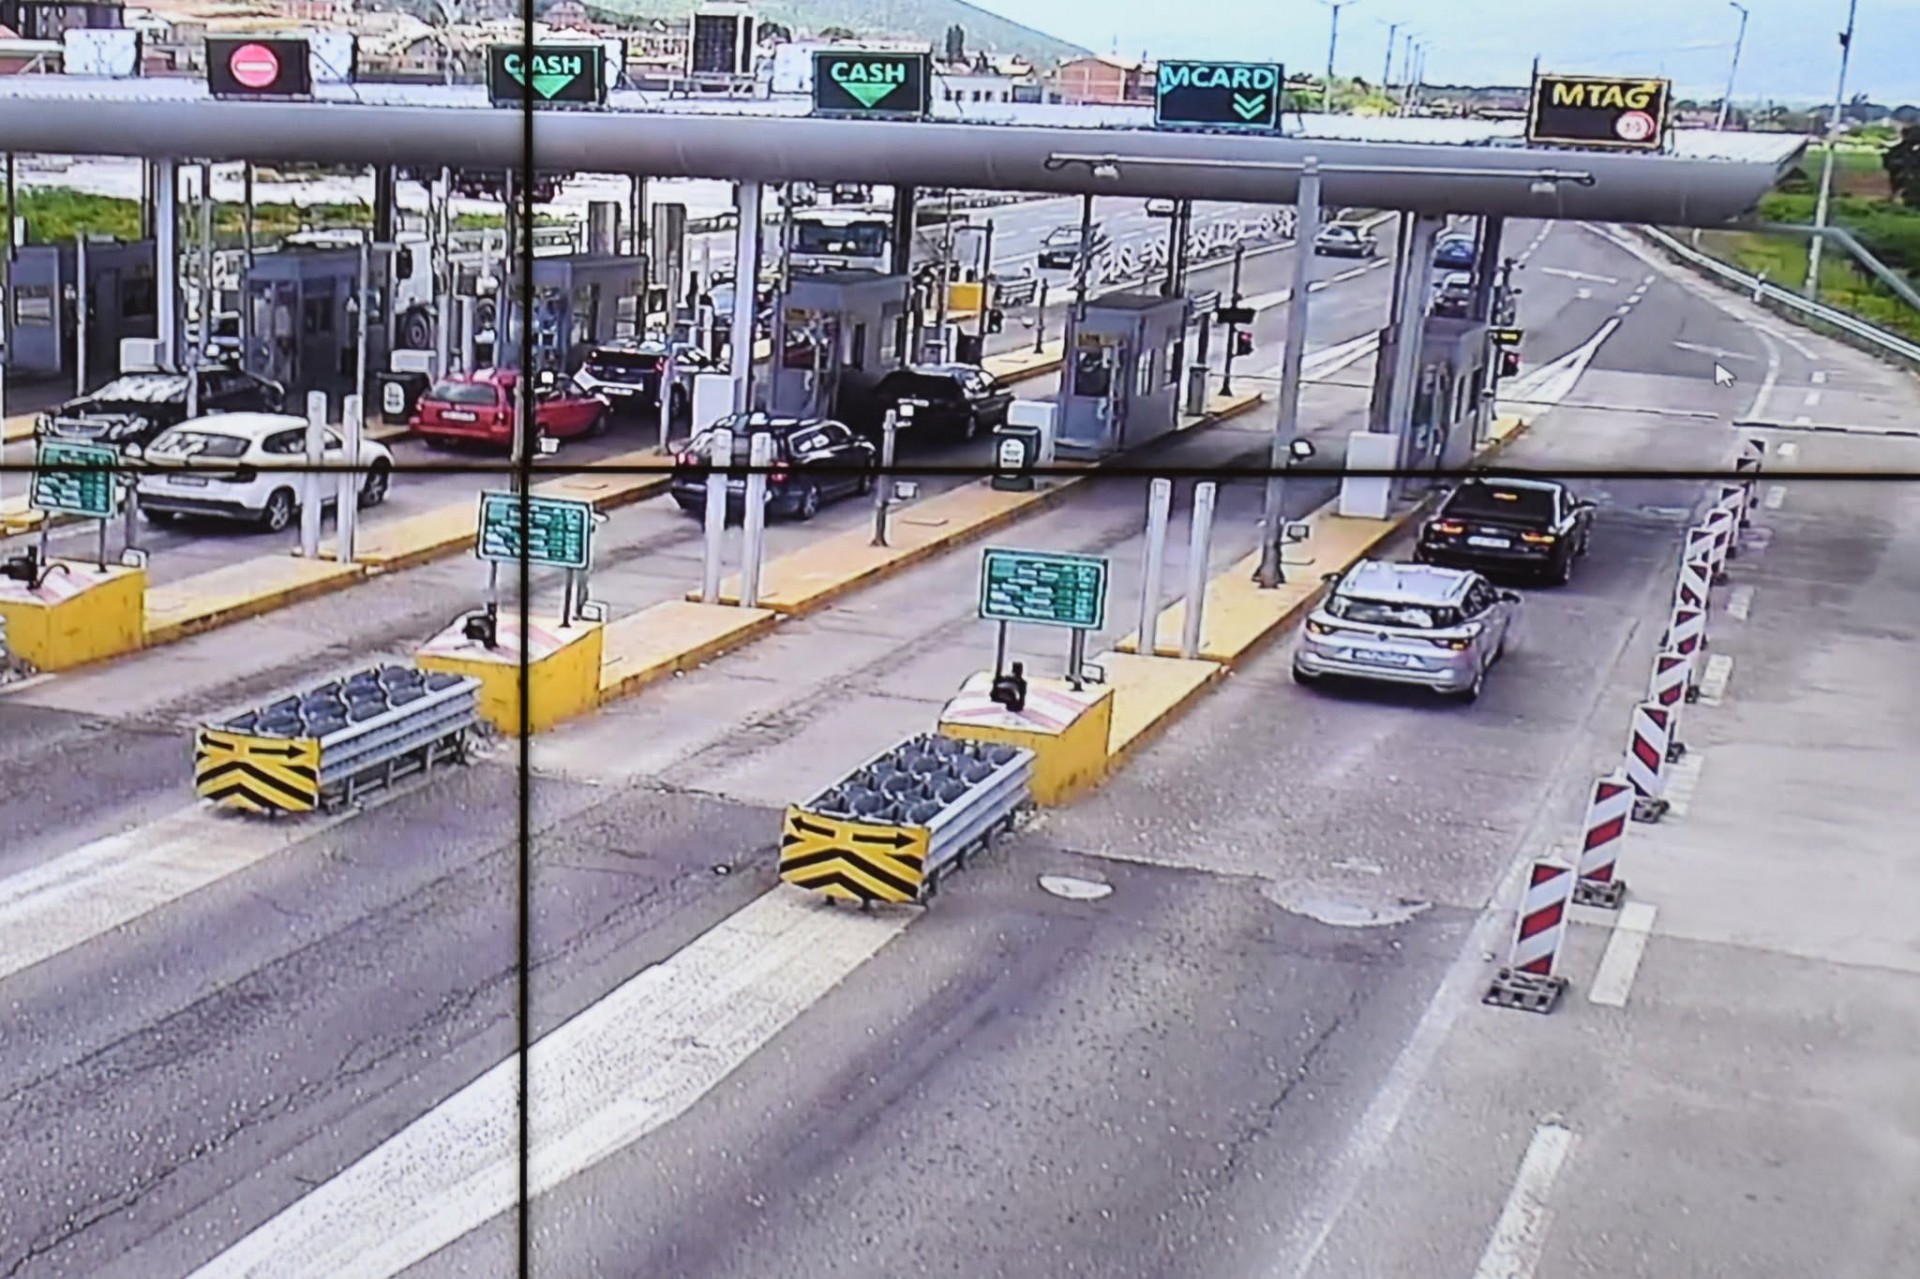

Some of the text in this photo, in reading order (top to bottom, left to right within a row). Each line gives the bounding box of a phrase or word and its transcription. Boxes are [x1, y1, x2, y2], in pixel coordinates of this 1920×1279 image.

[504, 54, 581, 75] CASH
[830, 62, 905, 82] CASH
[1160, 66, 1274, 89] MCARD
[1553, 82, 1650, 109] MTAG
